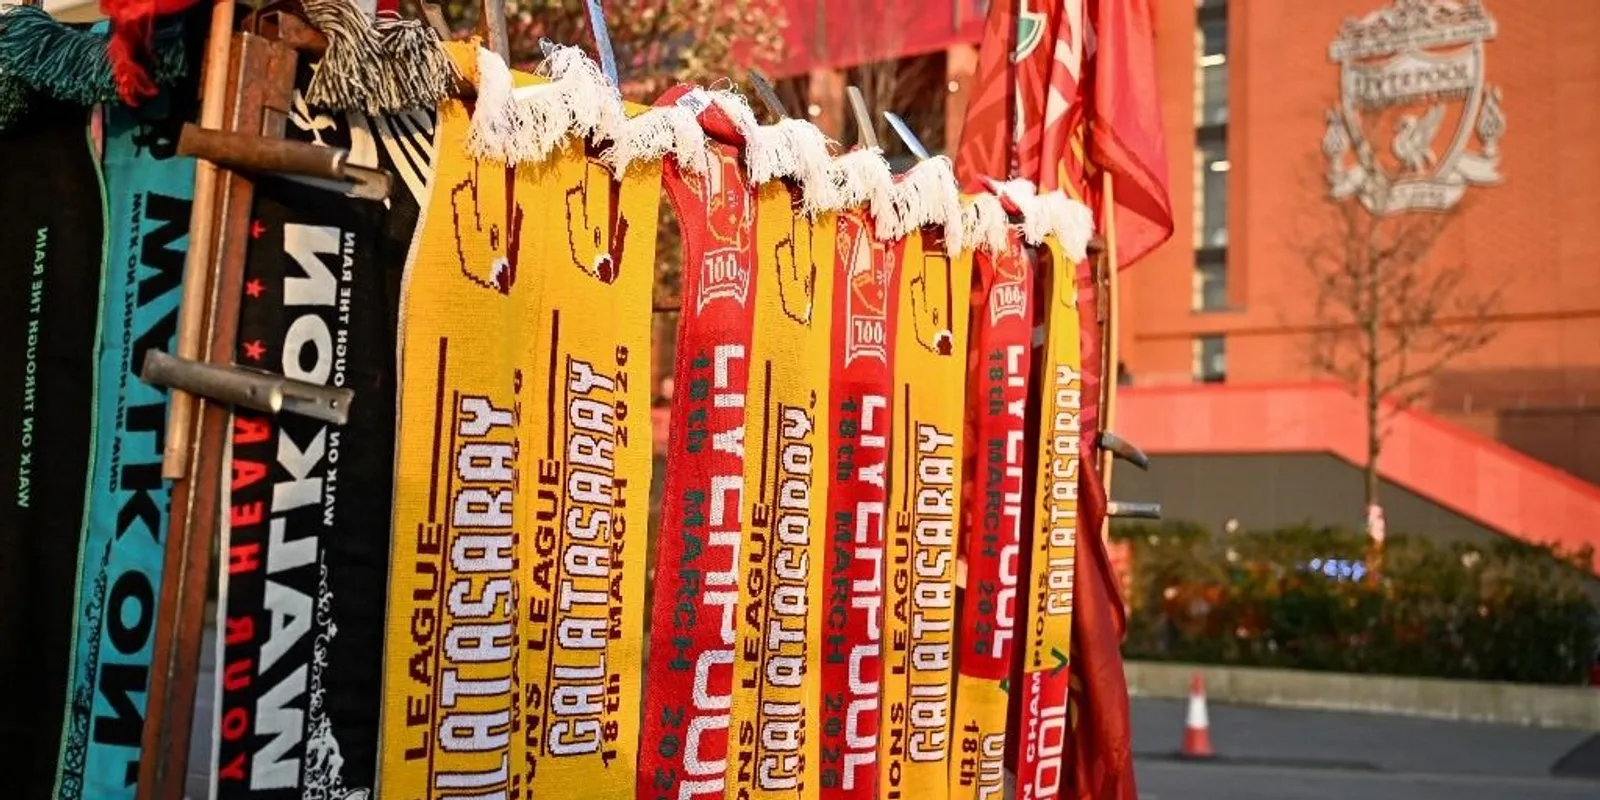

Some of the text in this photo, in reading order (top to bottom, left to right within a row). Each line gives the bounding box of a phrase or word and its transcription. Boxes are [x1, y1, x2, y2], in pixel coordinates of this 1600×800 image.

[687, 348, 711, 453] 18th
[527, 457, 561, 652] LEAGUE
[547, 356, 616, 759] GALATASARAY
[602, 346, 630, 770] 18th MARCH 2026
[668, 487, 706, 673] MARCH
[981, 438, 1004, 558] MARCH
[404, 522, 443, 762] LEAGUE
[432, 395, 513, 800] LATASARAY
[742, 503, 771, 690] LEAGUE
[820, 395, 858, 790] 18th MARCH 2026
[891, 511, 911, 676] LEAGUE
[974, 579, 997, 656] 2026
[959, 719, 980, 787] 18th
